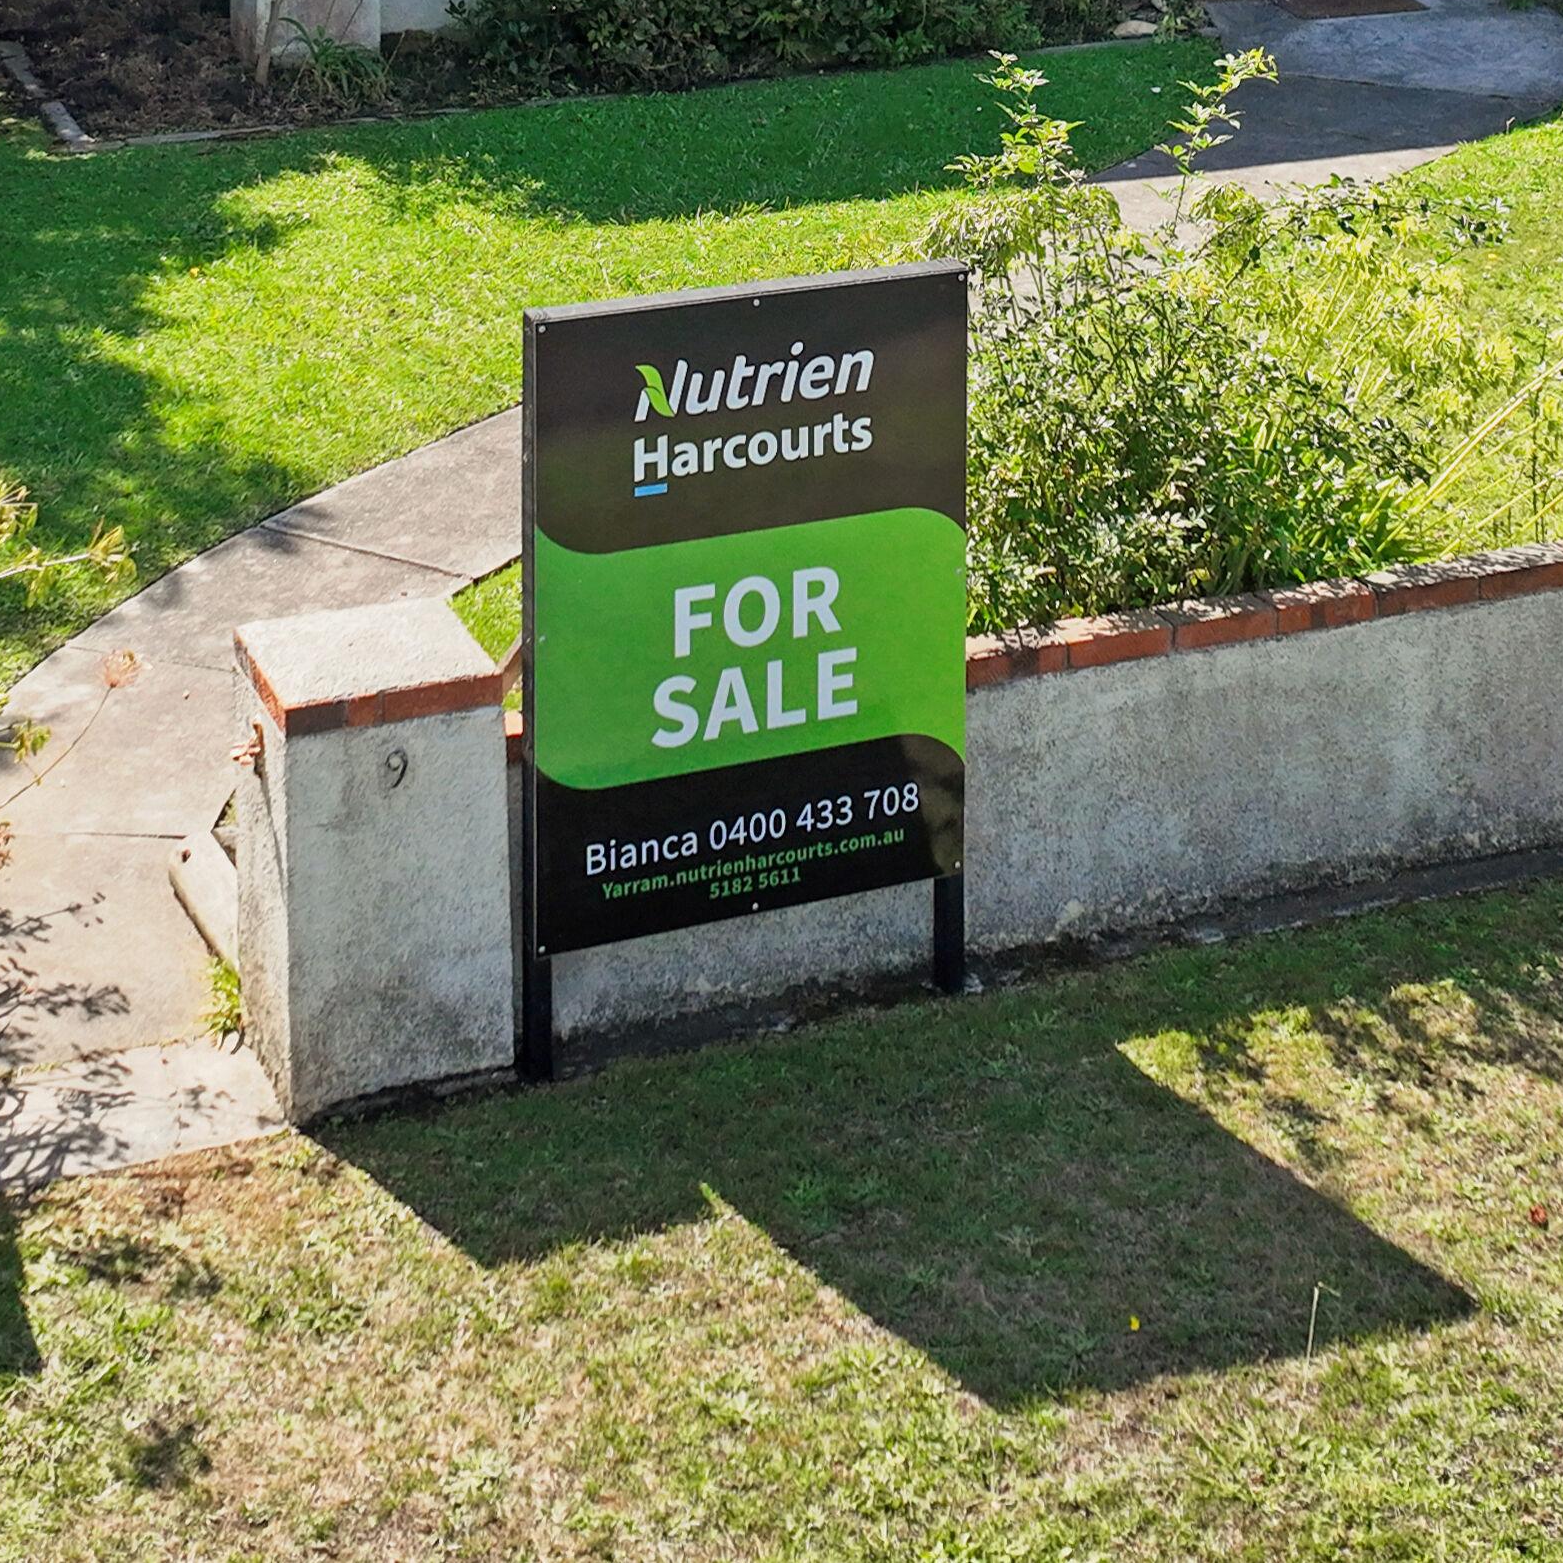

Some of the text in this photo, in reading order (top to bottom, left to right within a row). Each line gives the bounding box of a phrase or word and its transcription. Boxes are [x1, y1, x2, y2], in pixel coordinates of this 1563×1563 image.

[634, 341, 874, 422] Nutrien
[634, 413, 873, 484] Harcourts
[673, 565, 843, 658] FOR
[651, 647, 859, 748] SALE
[384, 748, 409, 789] 9
[586, 782, 920, 876] Bianca 0400 433 708
[602, 828, 905, 900] Yarram.nutrienharcourts.com.au
[709, 866, 802, 900] 5182 5611
